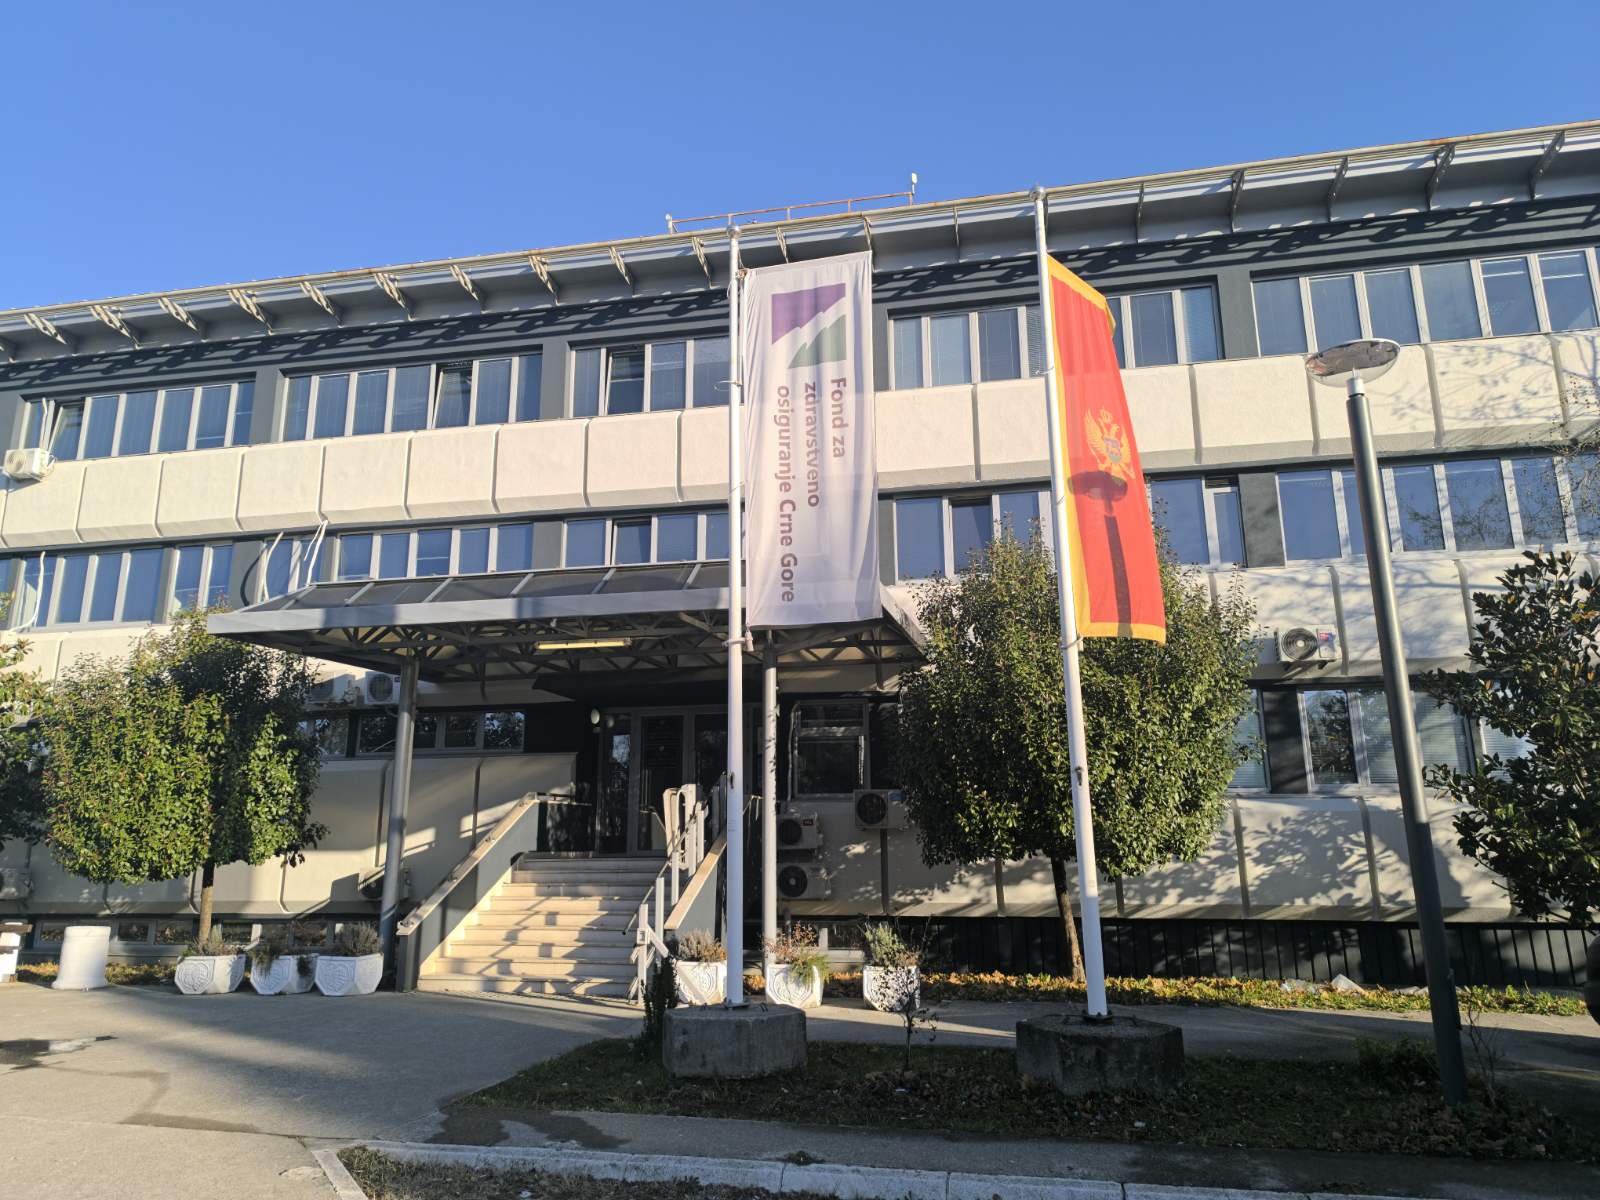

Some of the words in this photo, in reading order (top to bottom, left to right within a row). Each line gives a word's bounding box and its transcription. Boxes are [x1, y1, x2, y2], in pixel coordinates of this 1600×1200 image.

[831, 377, 849, 429] Fond
[774, 385, 796, 493] osiguranje
[804, 382, 820, 507] zdravstveno
[832, 436, 845, 458] za
[780, 499, 796, 546] Crne
[780, 553, 798, 602] Gore
